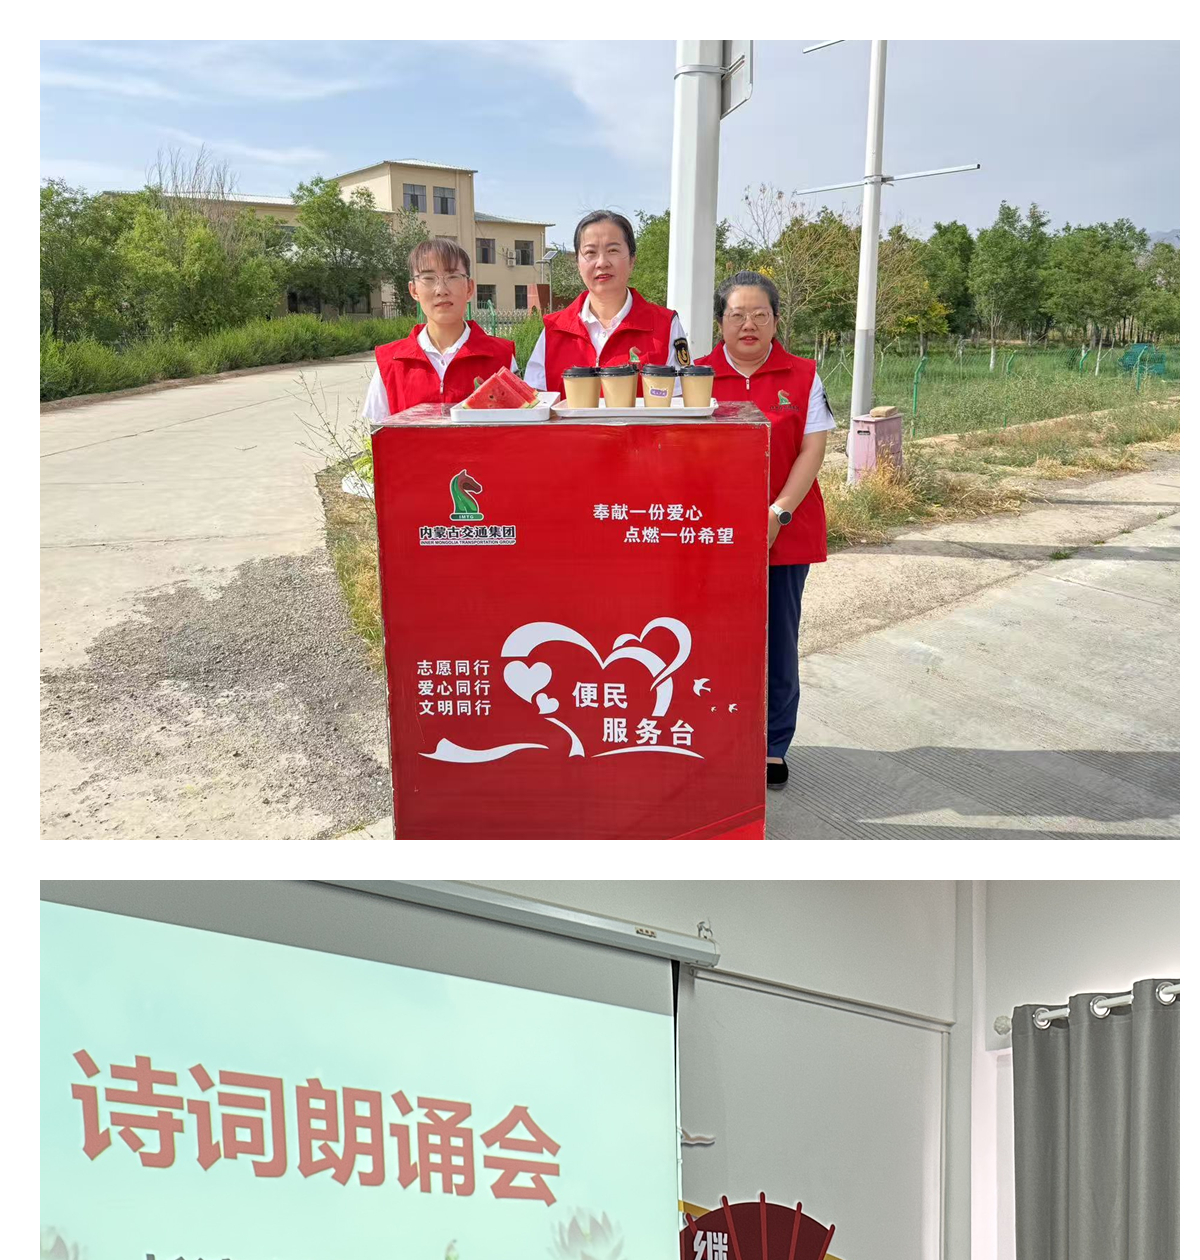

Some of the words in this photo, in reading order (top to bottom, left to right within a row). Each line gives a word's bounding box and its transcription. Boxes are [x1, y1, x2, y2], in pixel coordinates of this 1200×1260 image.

[593, 503, 703, 521] 奉献一份爱心
[419, 525, 516, 539] 内蒙古交通集团
[623, 526, 734, 545] 点燃一份希望
[416, 659, 490, 676] 志愿同行
[417, 679, 491, 696] 爱心同行
[572, 682, 628, 709] 便民
[418, 699, 492, 716] 文明同行
[602, 717, 695, 746] 服务台
[70, 1048, 562, 1207] 诗词朗诵会
